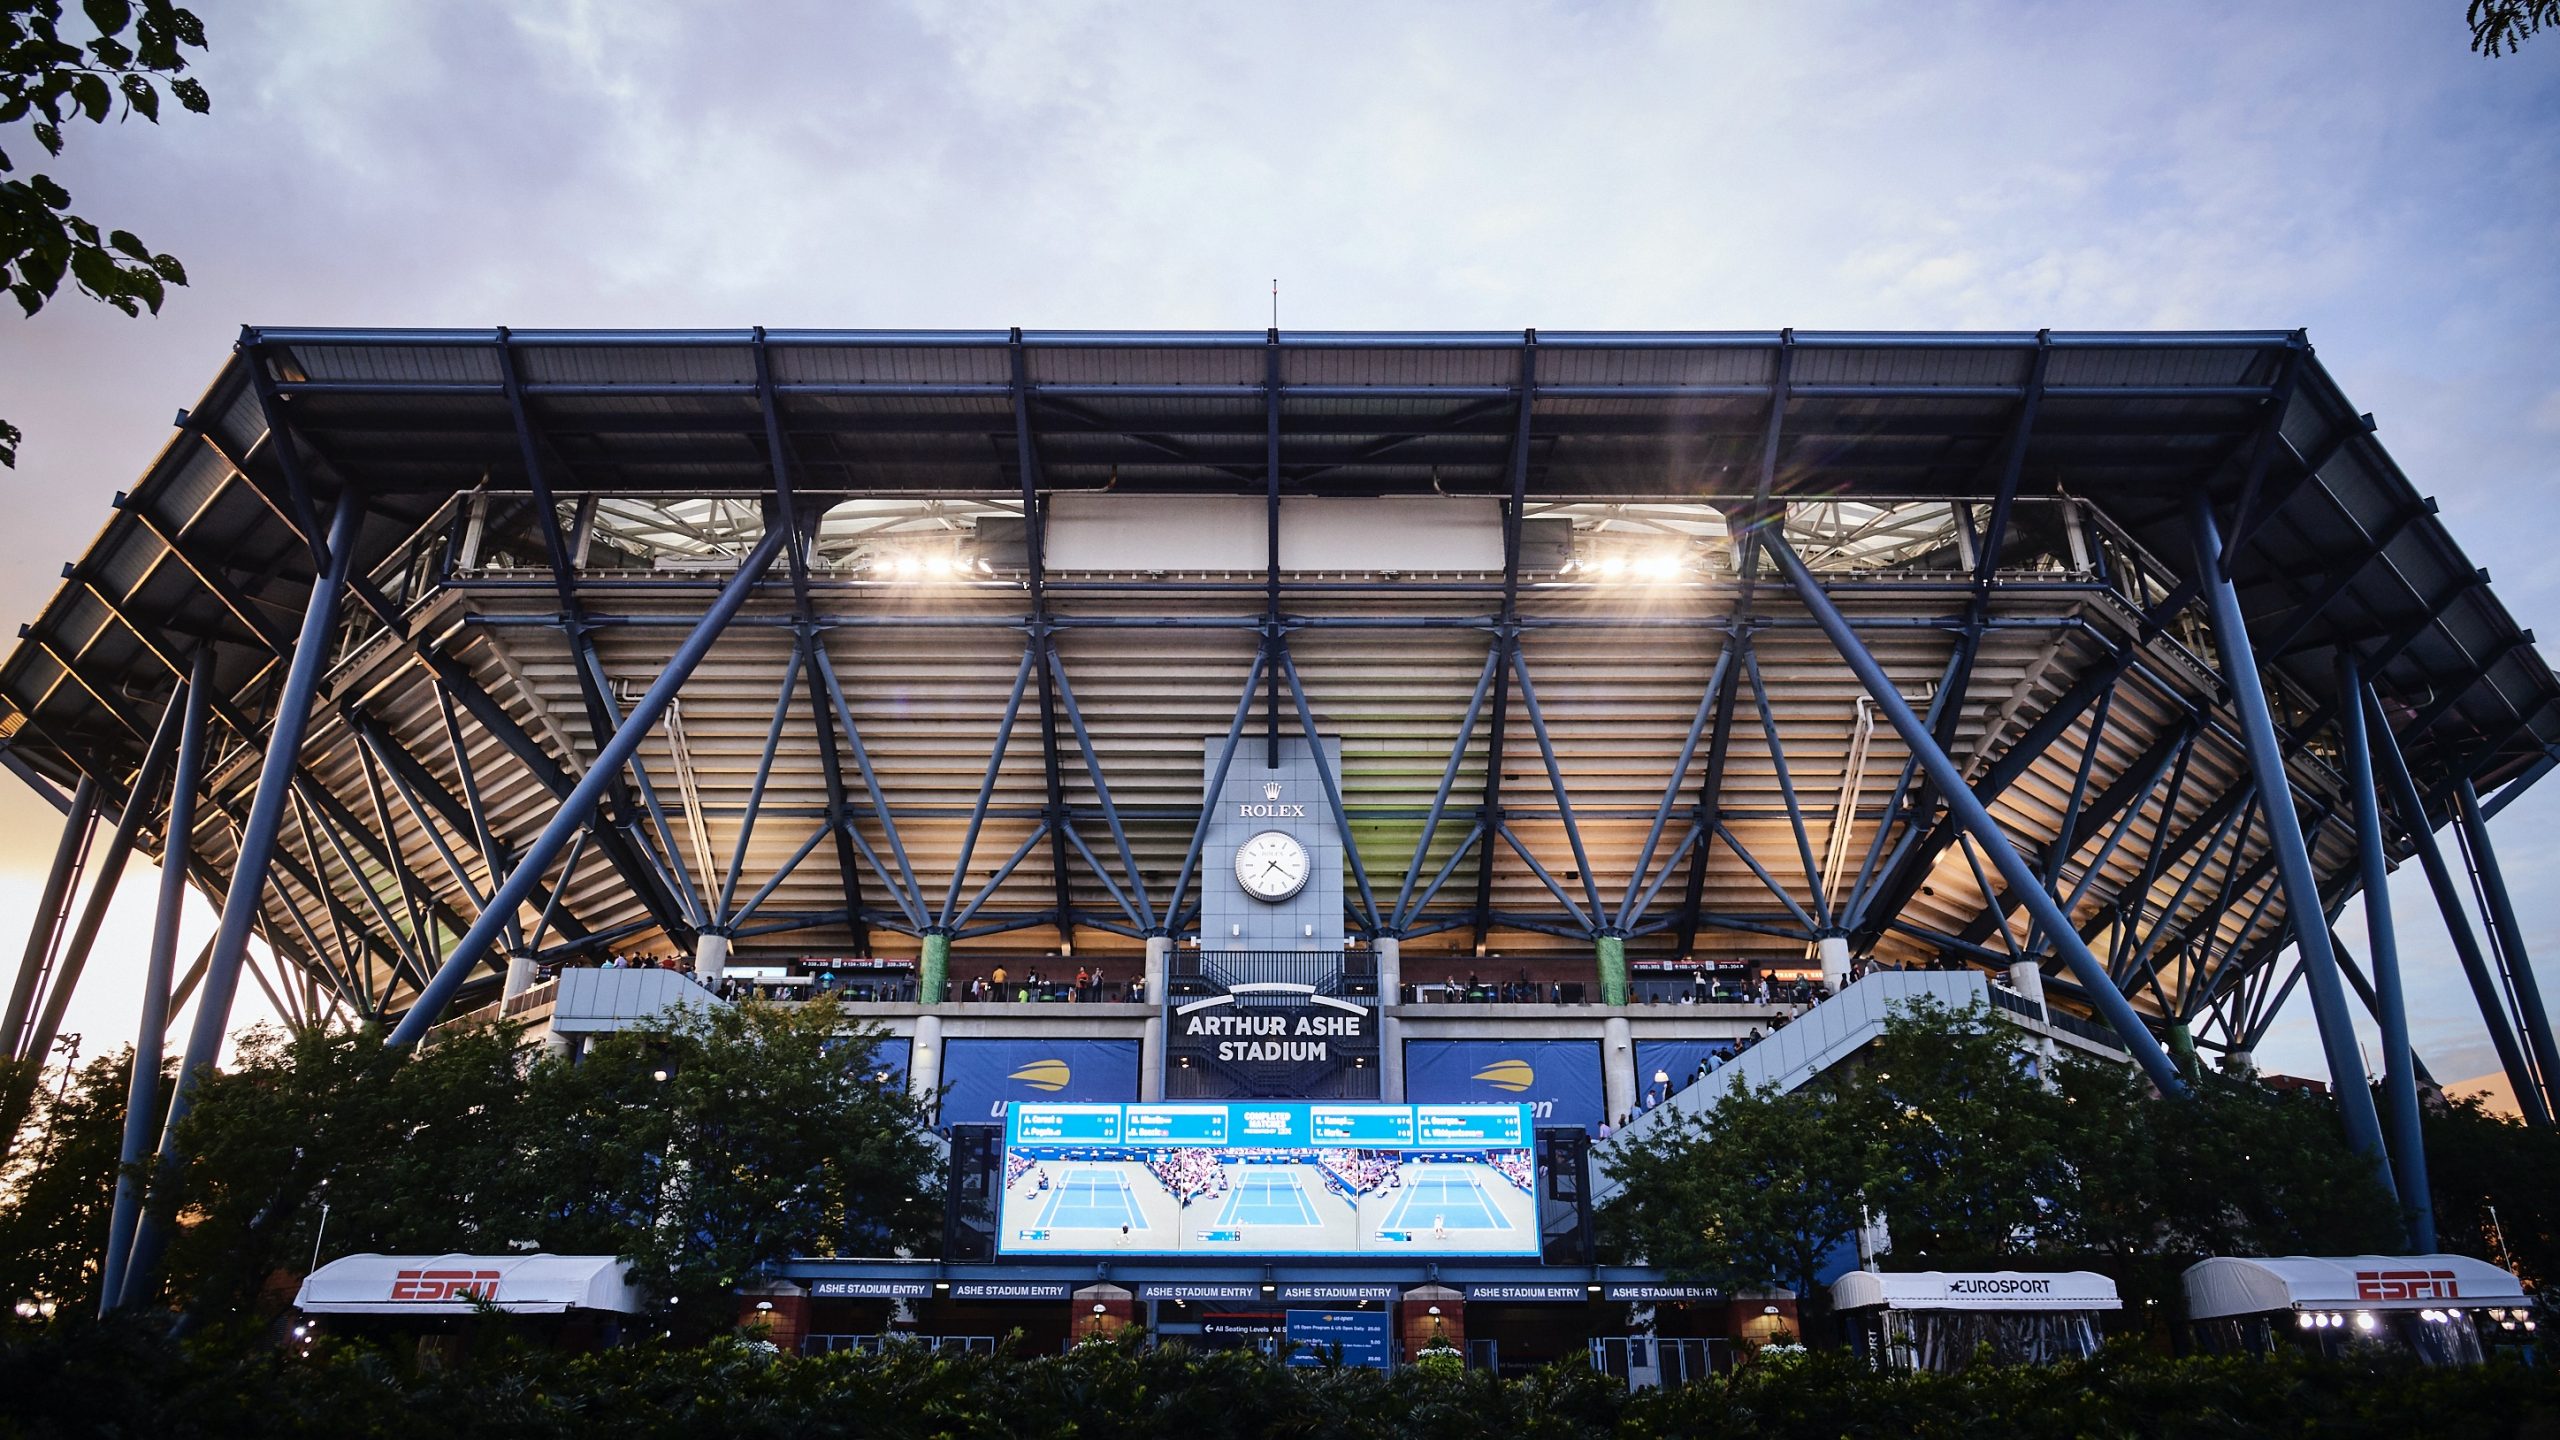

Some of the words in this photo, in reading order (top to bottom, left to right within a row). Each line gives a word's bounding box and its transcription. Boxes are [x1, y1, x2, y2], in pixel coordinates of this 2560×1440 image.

[1239, 804, 1304, 817] ROLEX
[1186, 1016, 1287, 1036] ARTHUR
[1294, 1016, 1360, 1036] ASHE
[1218, 1041, 1327, 1061] STADIUM
[390, 1270, 501, 1300] ESPN
[818, 1284, 845, 1293] ASHE
[847, 1284, 890, 1294] STADIUM
[892, 1285, 925, 1294] ENTRY
[1951, 1279, 2050, 1294] EUROSPORT
[2356, 1271, 2458, 1300] ESPN
[956, 1286, 983, 1295] ASHE
[985, 1286, 1029, 1296] STADIUM
[1031, 1287, 1064, 1296] ENTRY
[1146, 1287, 1172, 1297] ASHE
[1175, 1287, 1219, 1297] STADIUM
[1220, 1287, 1253, 1297] ENTRY
[1284, 1288, 1311, 1297] ASHE
[1313, 1288, 1357, 1297] STADIUM
[1359, 1288, 1391, 1297] ENTRY
[1473, 1288, 1500, 1297] ASHE
[1502, 1288, 1545, 1297] STADIUM
[1547, 1288, 1580, 1297] ENTRY
[1612, 1288, 1639, 1297] ASHE
[1641, 1288, 1684, 1297] STADIUM
[1224, 1325, 1248, 1333] Seating
